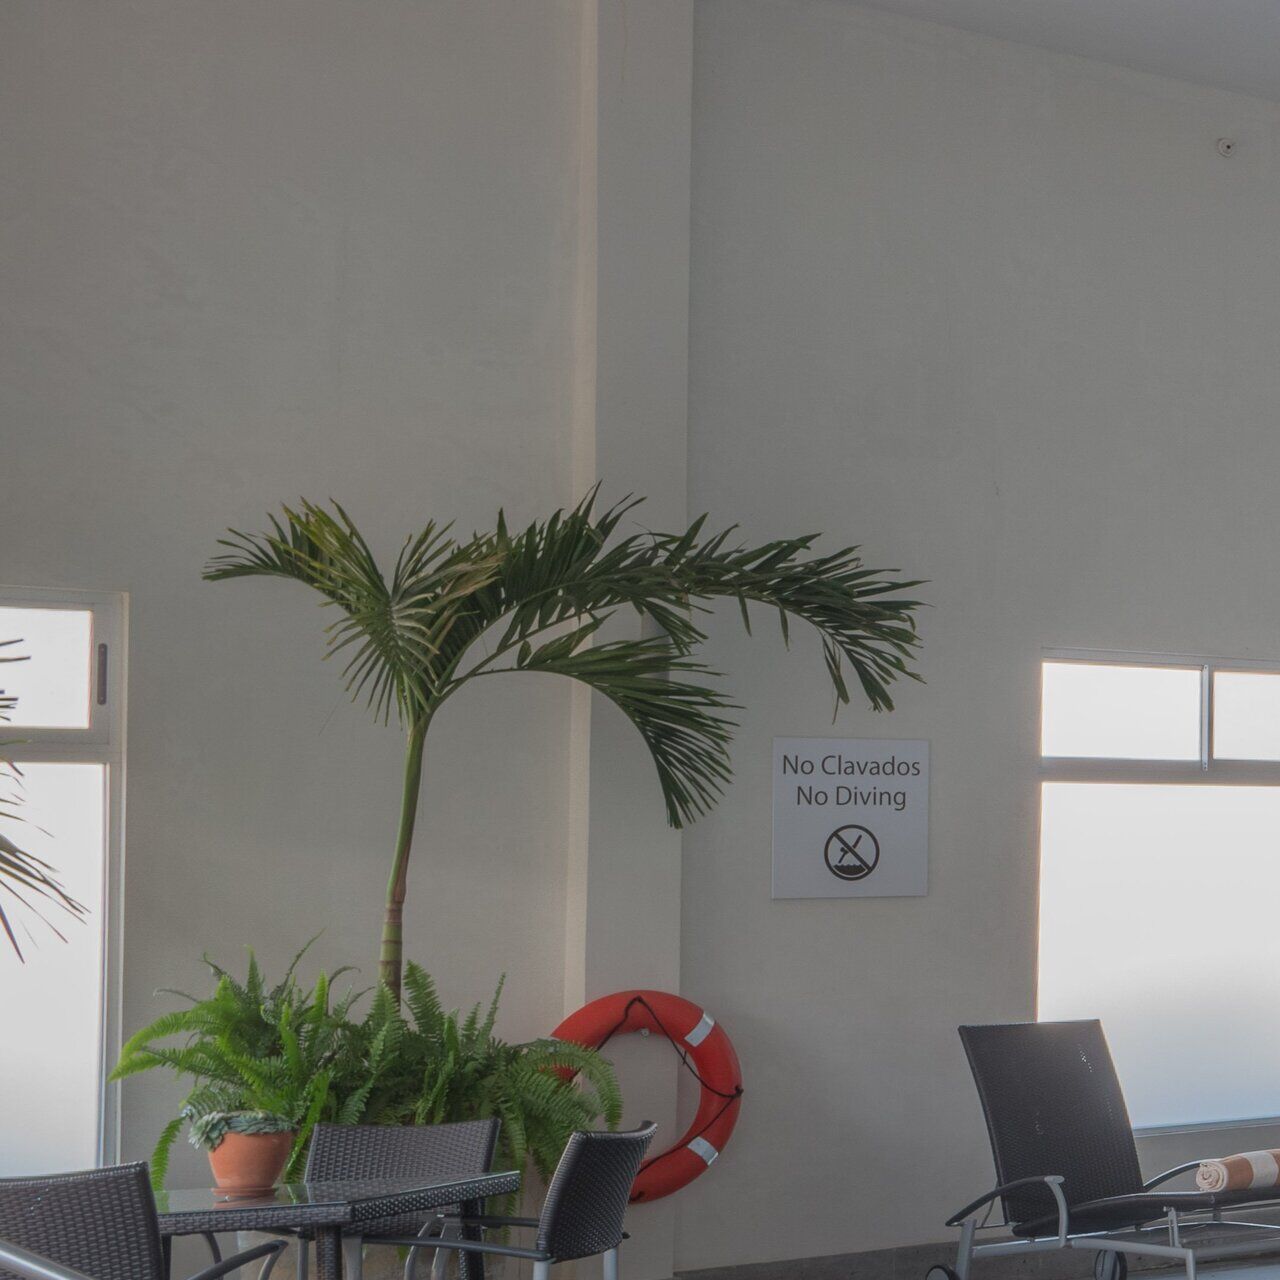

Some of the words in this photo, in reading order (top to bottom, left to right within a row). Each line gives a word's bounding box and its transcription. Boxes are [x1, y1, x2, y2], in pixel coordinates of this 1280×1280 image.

[783, 755, 814, 775] No
[821, 755, 921, 776] Clavados
[797, 786, 828, 805] No
[836, 786, 906, 811] Diving
